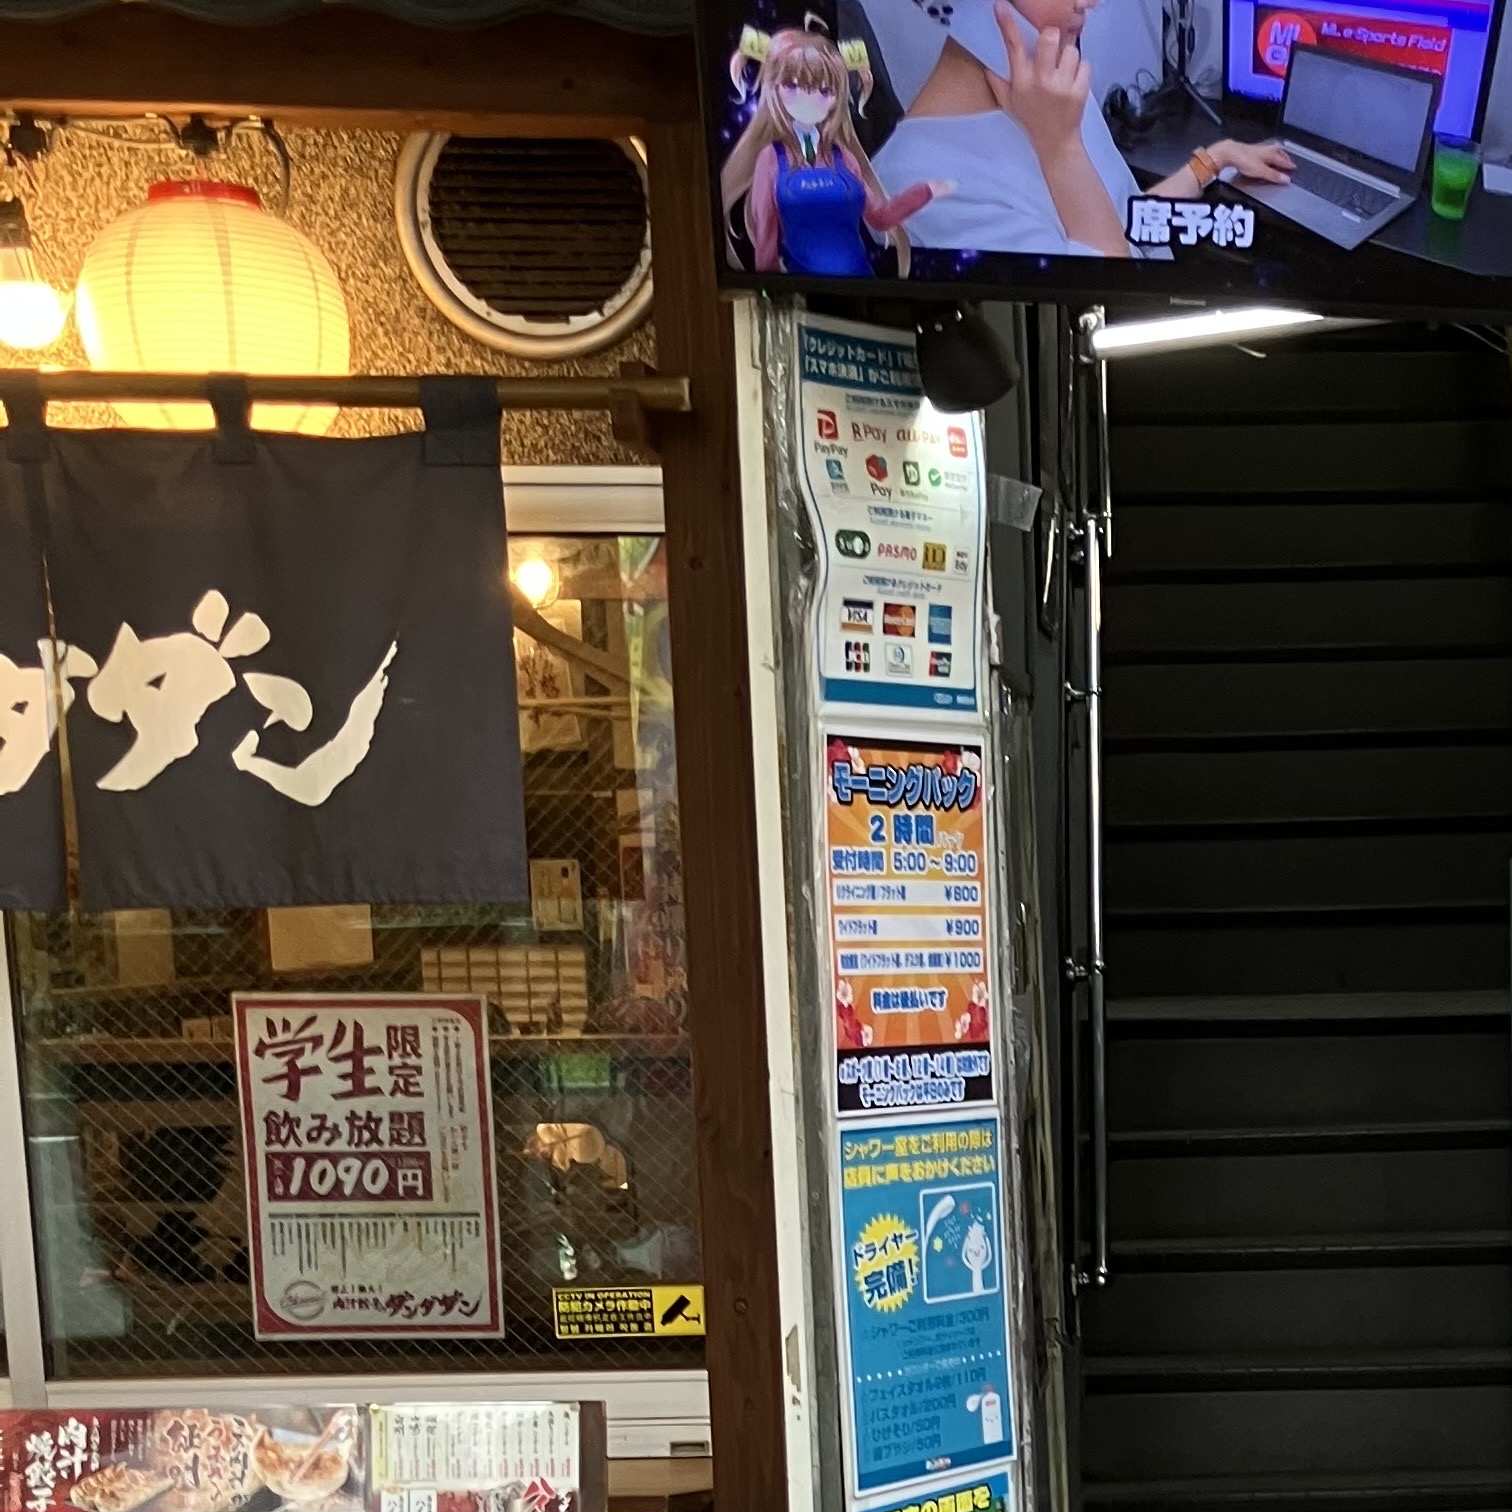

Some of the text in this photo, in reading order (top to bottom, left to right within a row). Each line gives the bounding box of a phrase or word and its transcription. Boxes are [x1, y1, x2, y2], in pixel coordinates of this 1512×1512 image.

[1131, 201, 1255, 247] 席予約
[814, 442, 848, 458] PayPay
[877, 543, 917, 561] PASMO
[833, 759, 978, 811] モーニングパック
[892, 814, 935, 846] 時間
[832, 849, 885, 873] 受付時間
[252, 1015, 425, 1103] 学生 限定
[262, 1109, 427, 1149] 飲み放題
[852, 1229, 919, 1269] ドライヤー
[584, 1292, 596, 1301] IN
